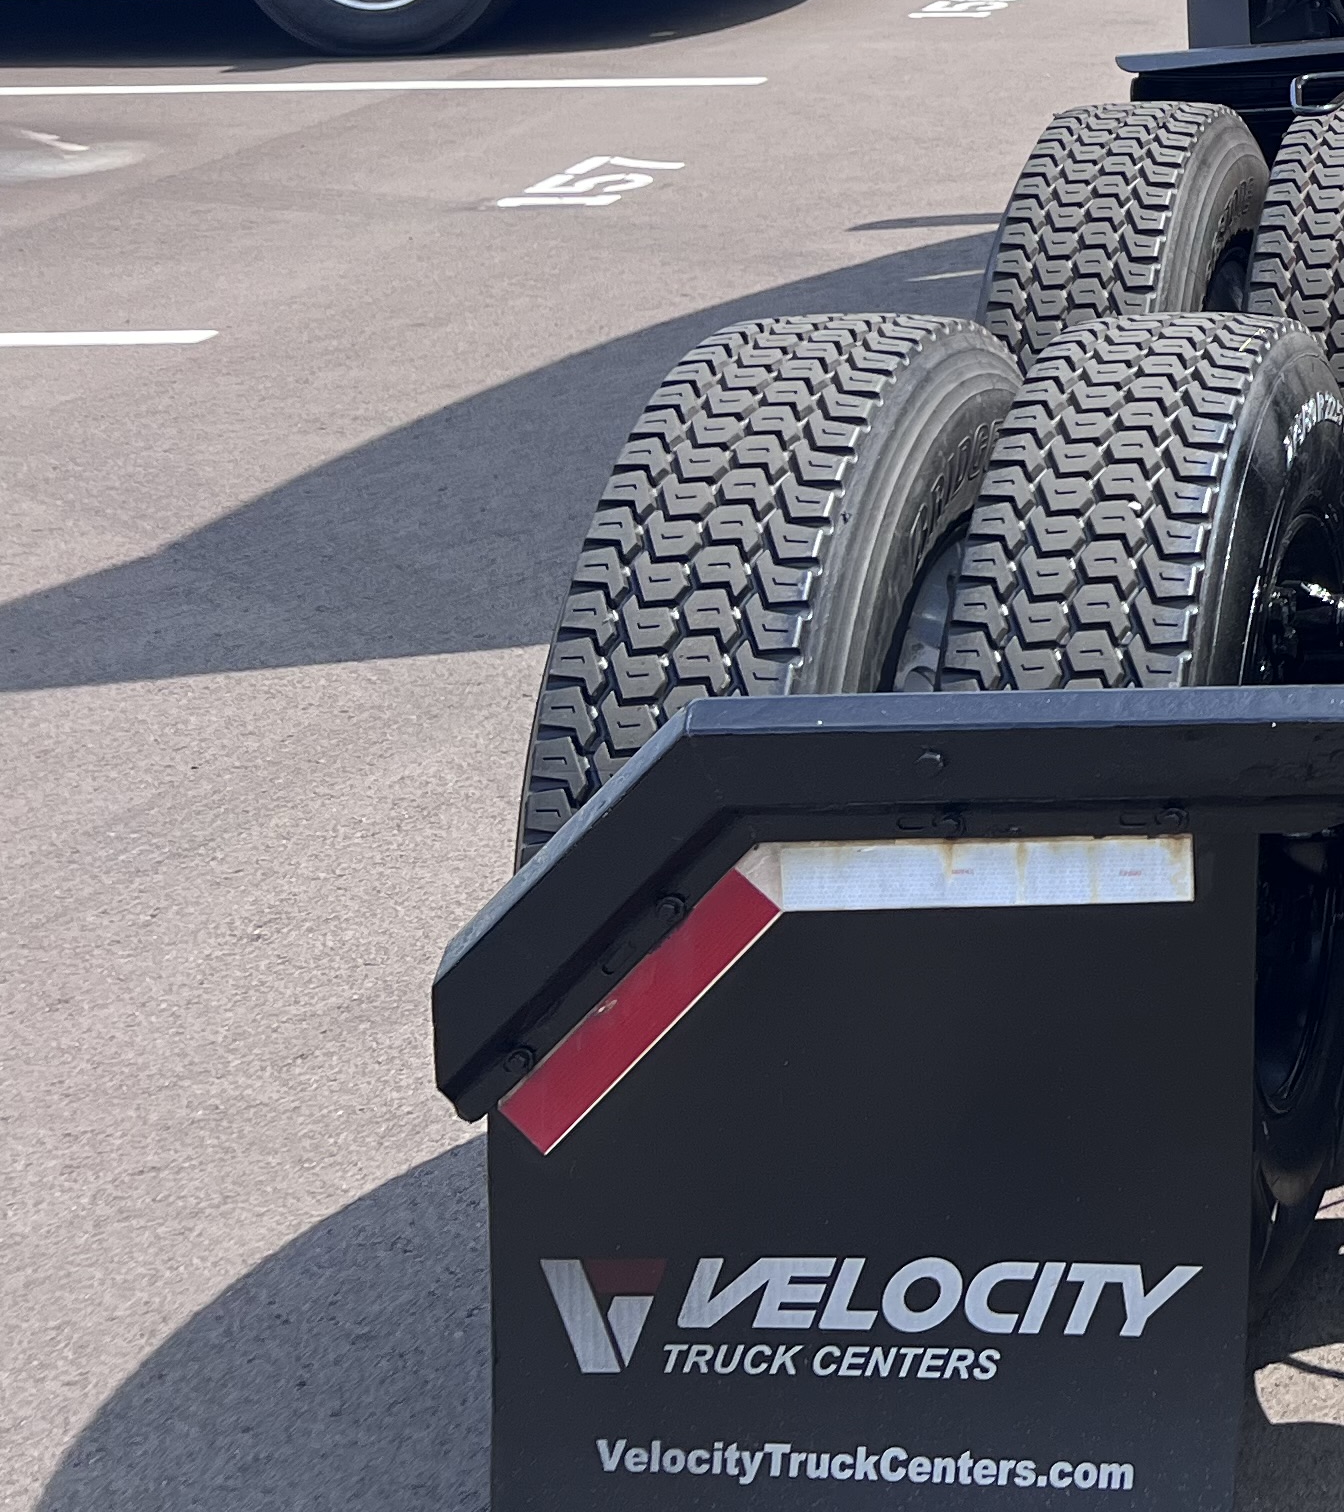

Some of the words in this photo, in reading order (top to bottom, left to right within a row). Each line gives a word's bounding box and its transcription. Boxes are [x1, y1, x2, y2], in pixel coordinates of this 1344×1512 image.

[496, 155, 686, 207] 157
[677, 1256, 1204, 1338] VELOCITY
[663, 1344, 799, 1376] TRUCK
[812, 1345, 1001, 1381] CENTERS
[596, 1438, 1135, 1491] VelocityTruckCenters.com
